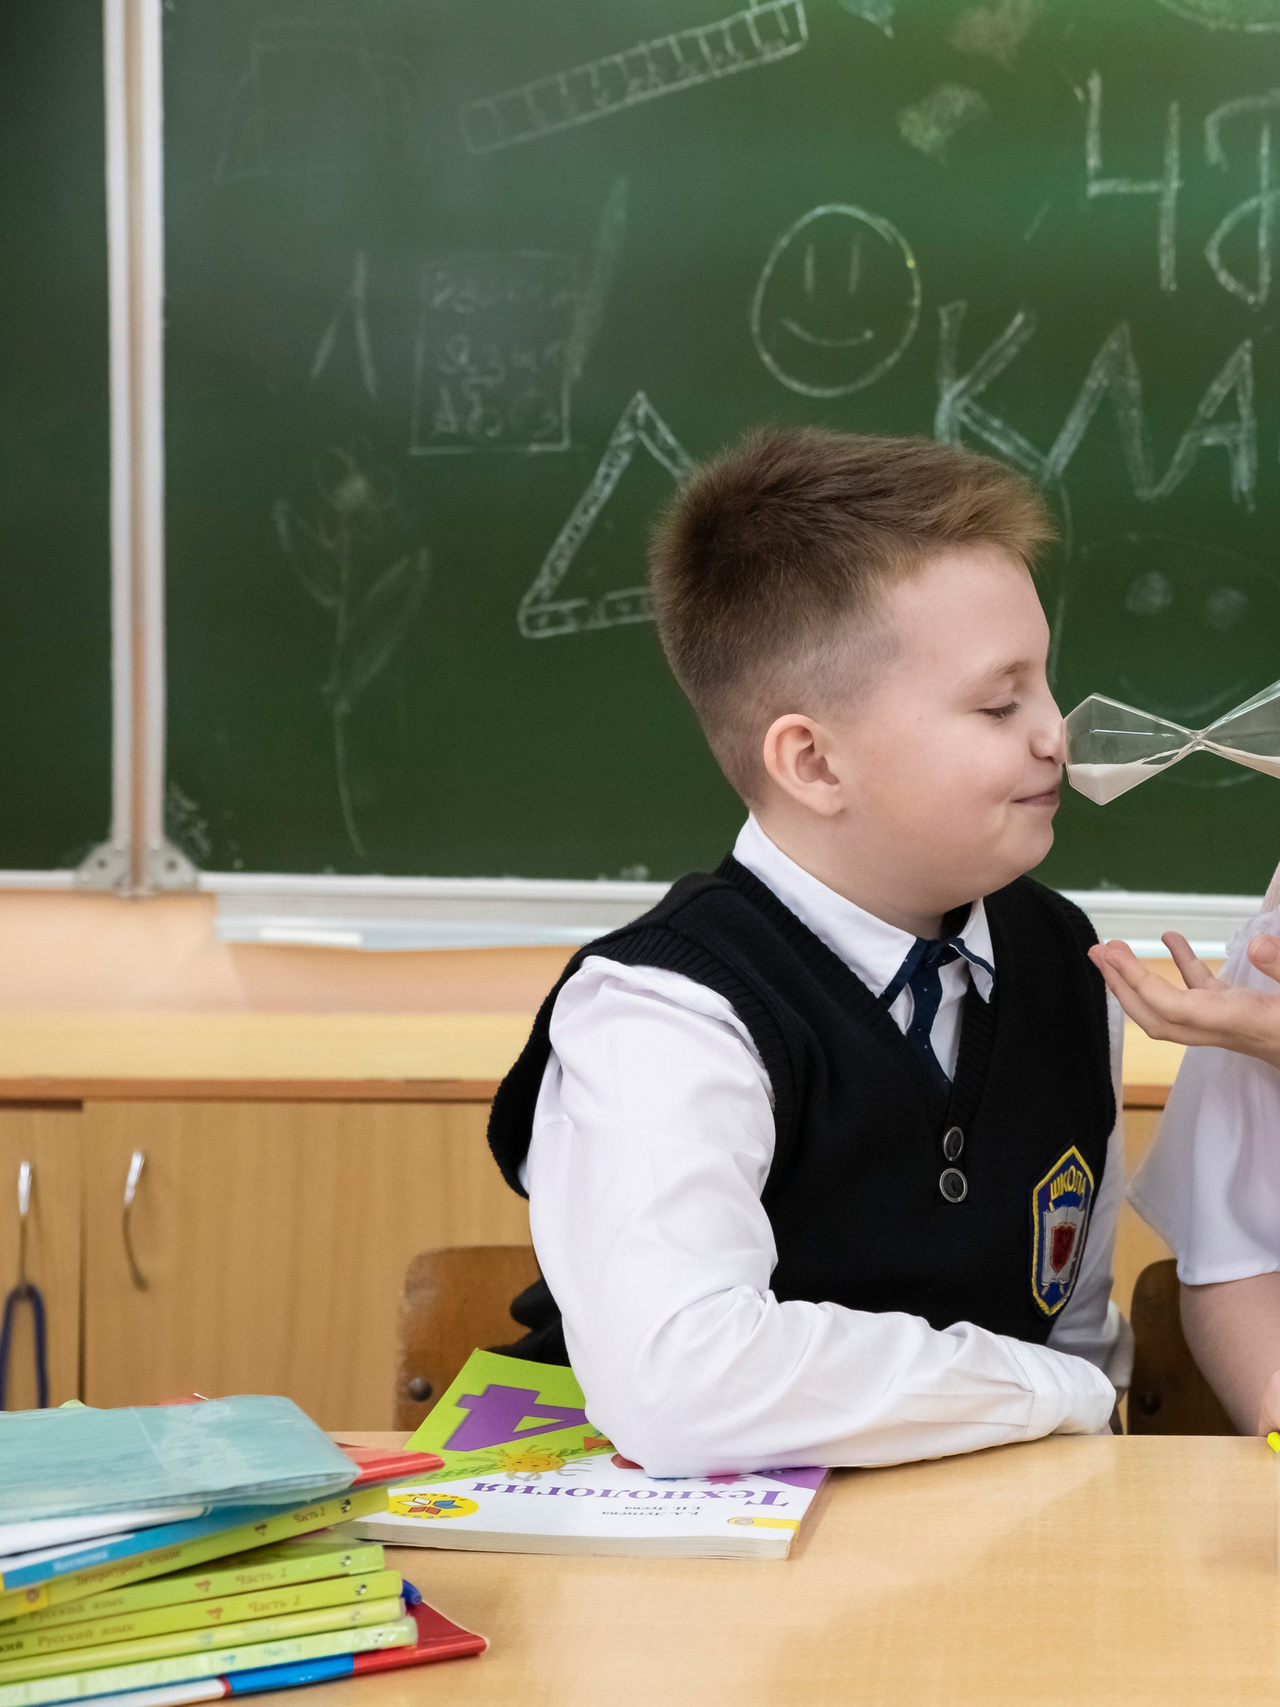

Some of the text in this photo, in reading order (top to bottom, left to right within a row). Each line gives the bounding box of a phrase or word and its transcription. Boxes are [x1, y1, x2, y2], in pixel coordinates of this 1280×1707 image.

[1050, 1165, 1087, 1199] ШКОЛА
[444, 1384, 588, 1452] 4
[470, 1481, 790, 1509] Технология
[293, 1508, 319, 1524] Часть
[319, 1506, 326, 1517] 2
[236, 1571, 275, 1585] Часть
[280, 1567, 287, 1578] 2
[38, 1629, 93, 1647] Русский
[248, 1599, 288, 1612] Часть
[293, 1595, 300, 1606] 2
